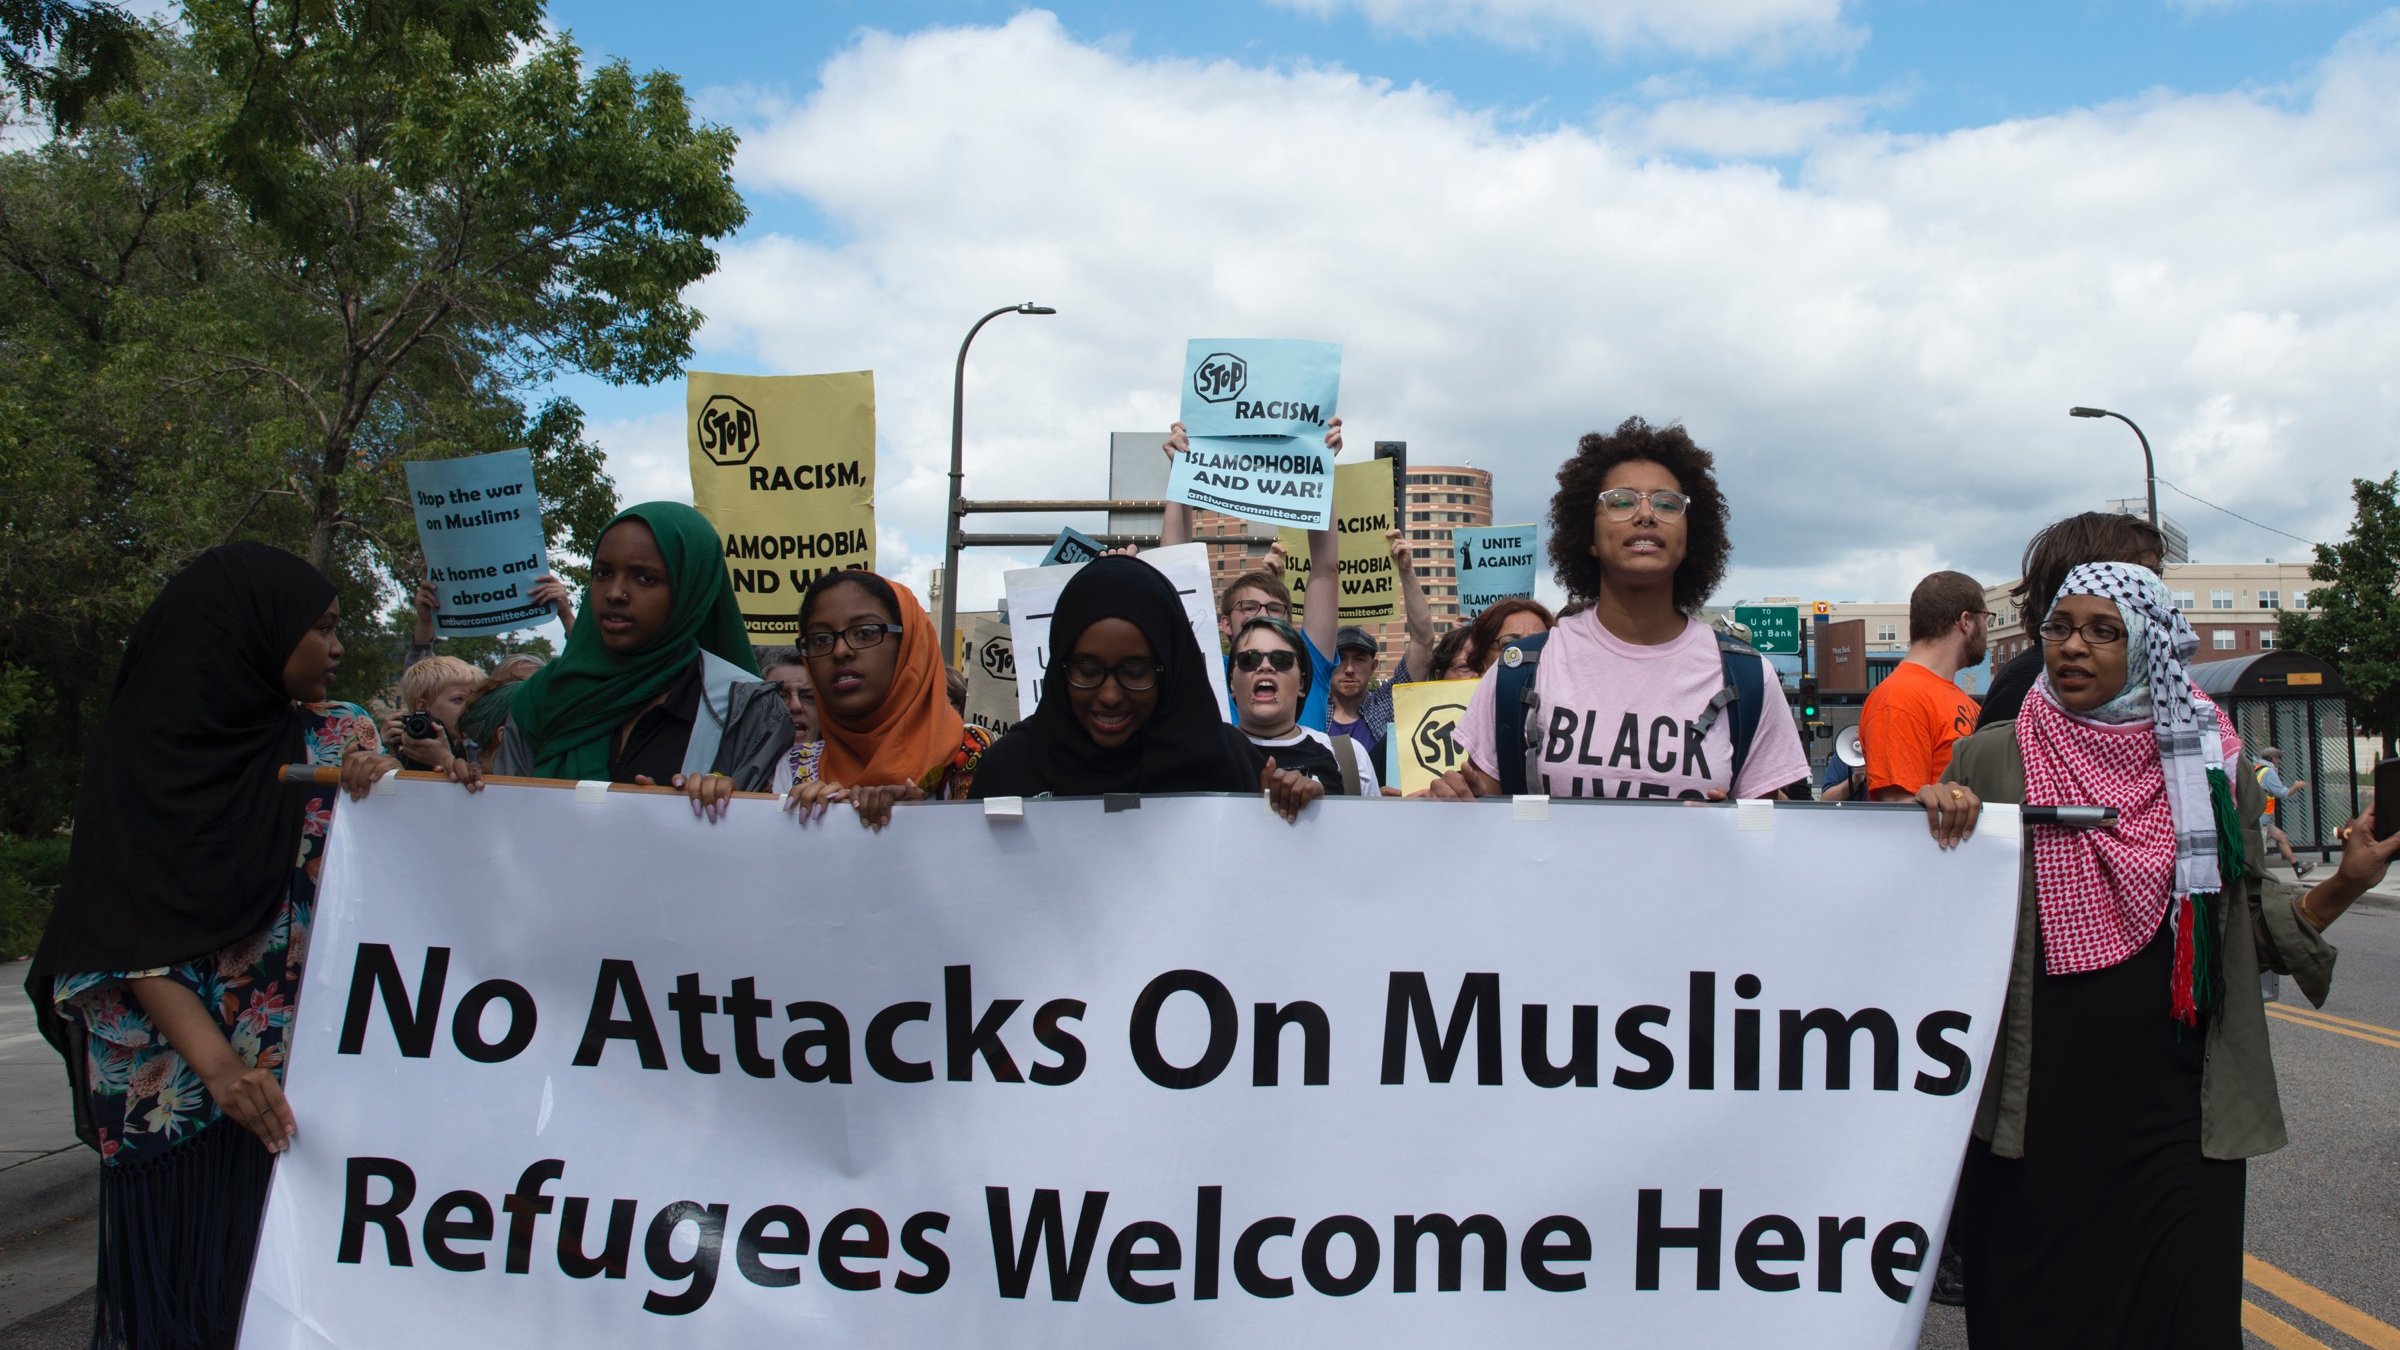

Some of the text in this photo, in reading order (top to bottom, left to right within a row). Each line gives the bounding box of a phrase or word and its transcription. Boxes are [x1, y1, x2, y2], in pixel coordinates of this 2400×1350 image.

[1199, 362, 1242, 395] STOP
[1235, 400, 1325, 427] RACISM,
[703, 408, 751, 455] STOP
[750, 460, 866, 491] RACISM,
[1184, 451, 1324, 475] ISLAMOPHOBIA
[417, 483, 523, 508] Stop the war
[1193, 470, 1323, 499] AND WAR!
[426, 508, 520, 531] on Muslims
[1188, 490, 1321, 523] antiwarcommittee.org
[1337, 513, 1390, 533] ACISM,
[725, 528, 868, 560] AMOPHOBIA
[1061, 542, 1095, 564] Sto
[1482, 537, 1522, 550] UNITE
[430, 553, 539, 583] At home and
[1285, 555, 1392, 575] ISLAPHOBIA
[1478, 554, 1533, 568] AGAINST
[733, 568, 780, 594] ND
[1342, 576, 1392, 595] WAR!
[452, 583, 518, 606] abroad
[441, 606, 546, 627] antiwarcommittee.org
[1750, 618, 1783, 626] U of M
[1420, 720, 1465, 767] ST
[1545, 706, 1711, 780] BLACK
[338, 942, 1972, 1097] No Attacks On Muslims
[337, 1156, 1930, 1316] Refugees Welcome Here
